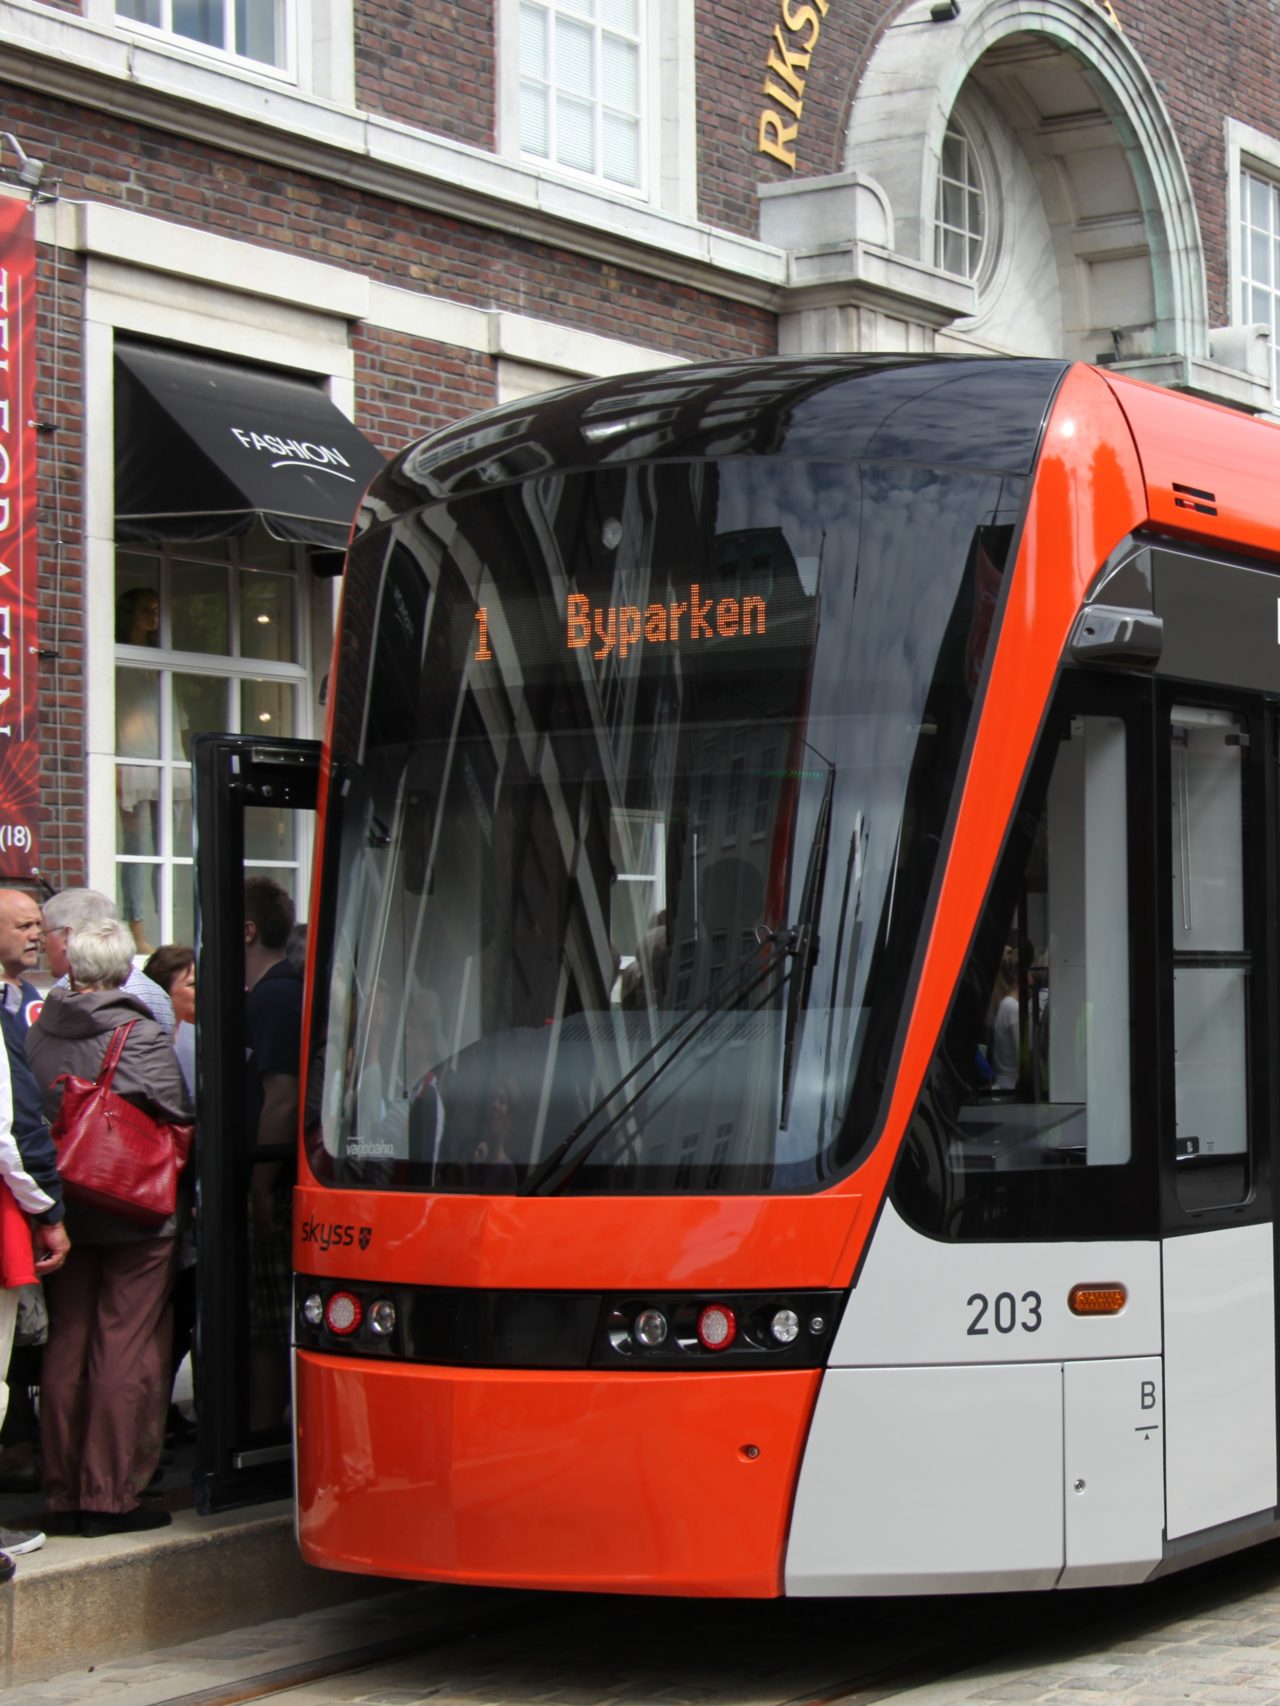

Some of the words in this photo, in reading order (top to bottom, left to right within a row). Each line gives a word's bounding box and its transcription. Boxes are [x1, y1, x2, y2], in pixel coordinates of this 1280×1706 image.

[759, 0, 829, 170] RIKS
[231, 427, 351, 468] FASHION
[474, 607, 492, 661] 1
[566, 584, 767, 661] Byparken
[0, 824, 32, 854] (18)
[302, 1215, 355, 1252] skyss
[966, 1290, 1042, 1336] 203
[1140, 1380, 1157, 1410] B
